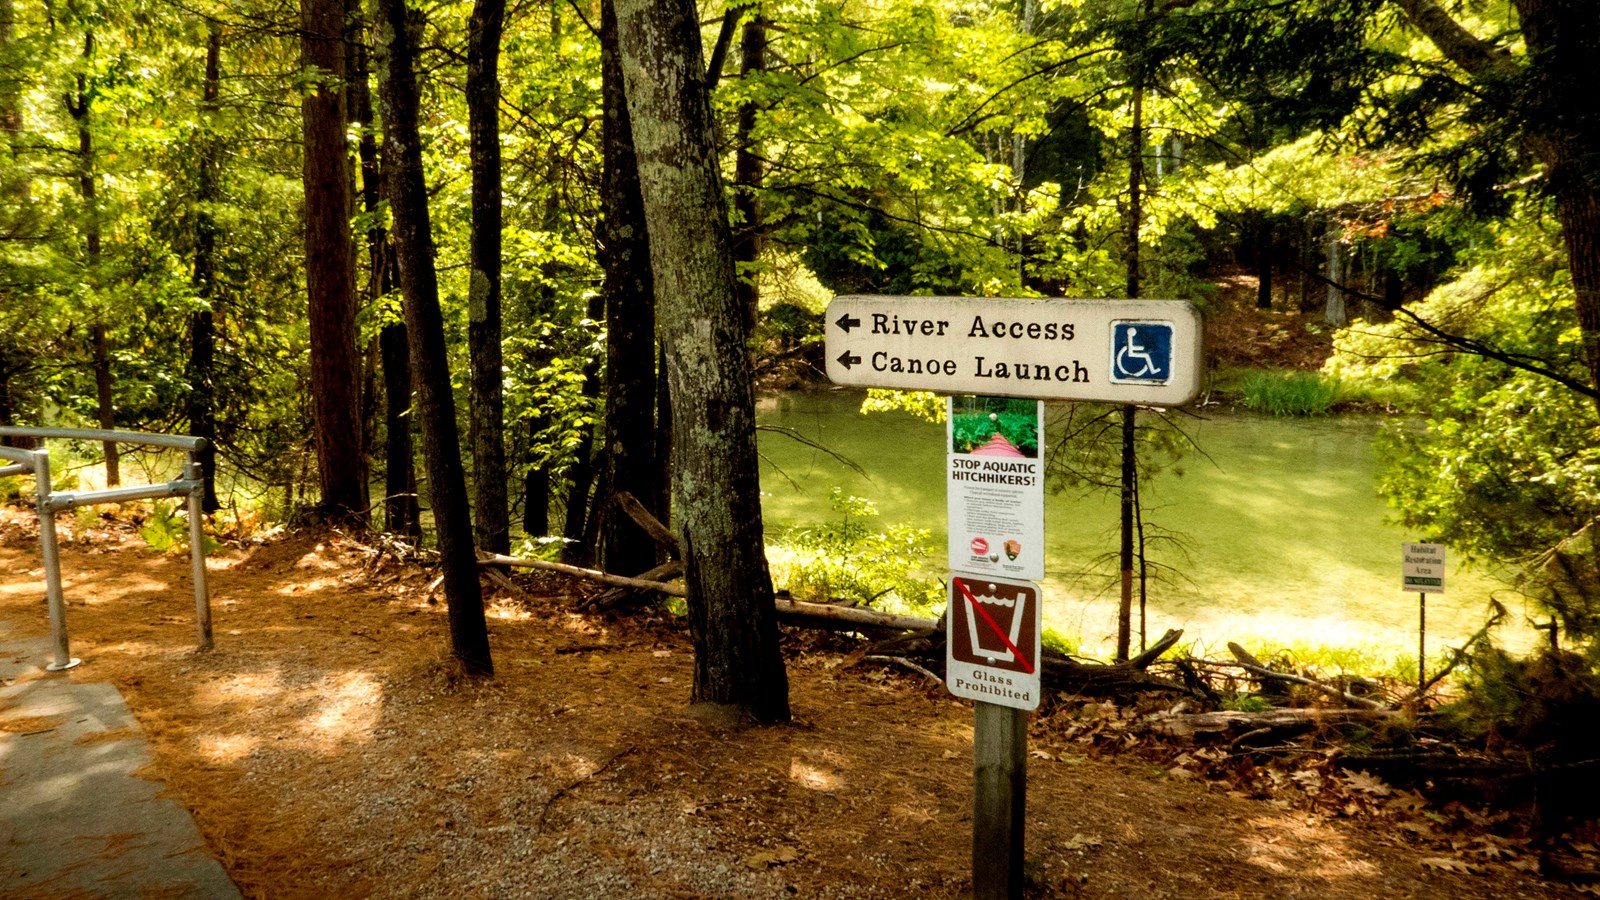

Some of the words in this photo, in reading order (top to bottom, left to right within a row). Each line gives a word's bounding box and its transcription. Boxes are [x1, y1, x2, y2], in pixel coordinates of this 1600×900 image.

[871, 313, 949, 337] River
[968, 316, 1075, 341] Access
[871, 352, 957, 376] Canoe
[974, 356, 1090, 383] Launch
[952, 458, 981, 470] STOP
[983, 461, 1036, 473] AQUATIC
[952, 470, 1036, 486] HITCHHIKERS!
[973, 670, 1013, 685] Glass
[955, 678, 1031, 702] Prohibited
